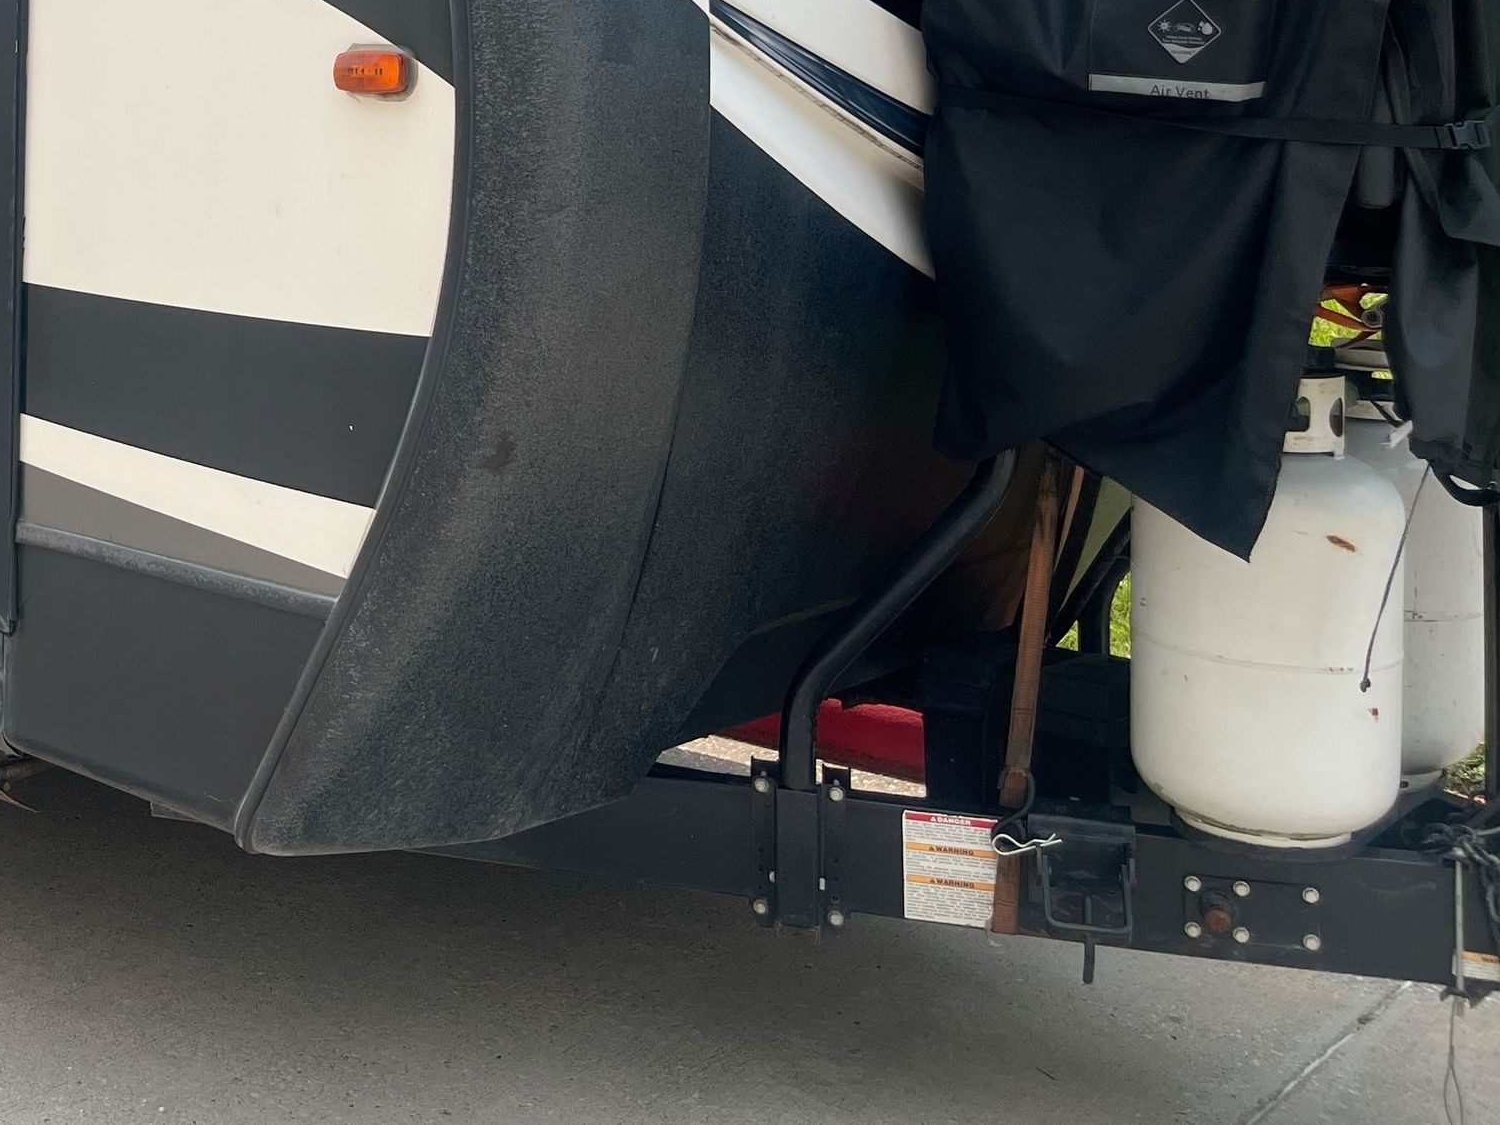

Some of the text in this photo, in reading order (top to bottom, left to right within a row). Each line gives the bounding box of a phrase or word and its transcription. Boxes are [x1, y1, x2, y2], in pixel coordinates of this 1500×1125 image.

[1150, 84, 1209, 99] Air Vent
[937, 816, 971, 826] DANGER
[935, 845, 974, 856] WARNING
[935, 878, 975, 889] WARNING
